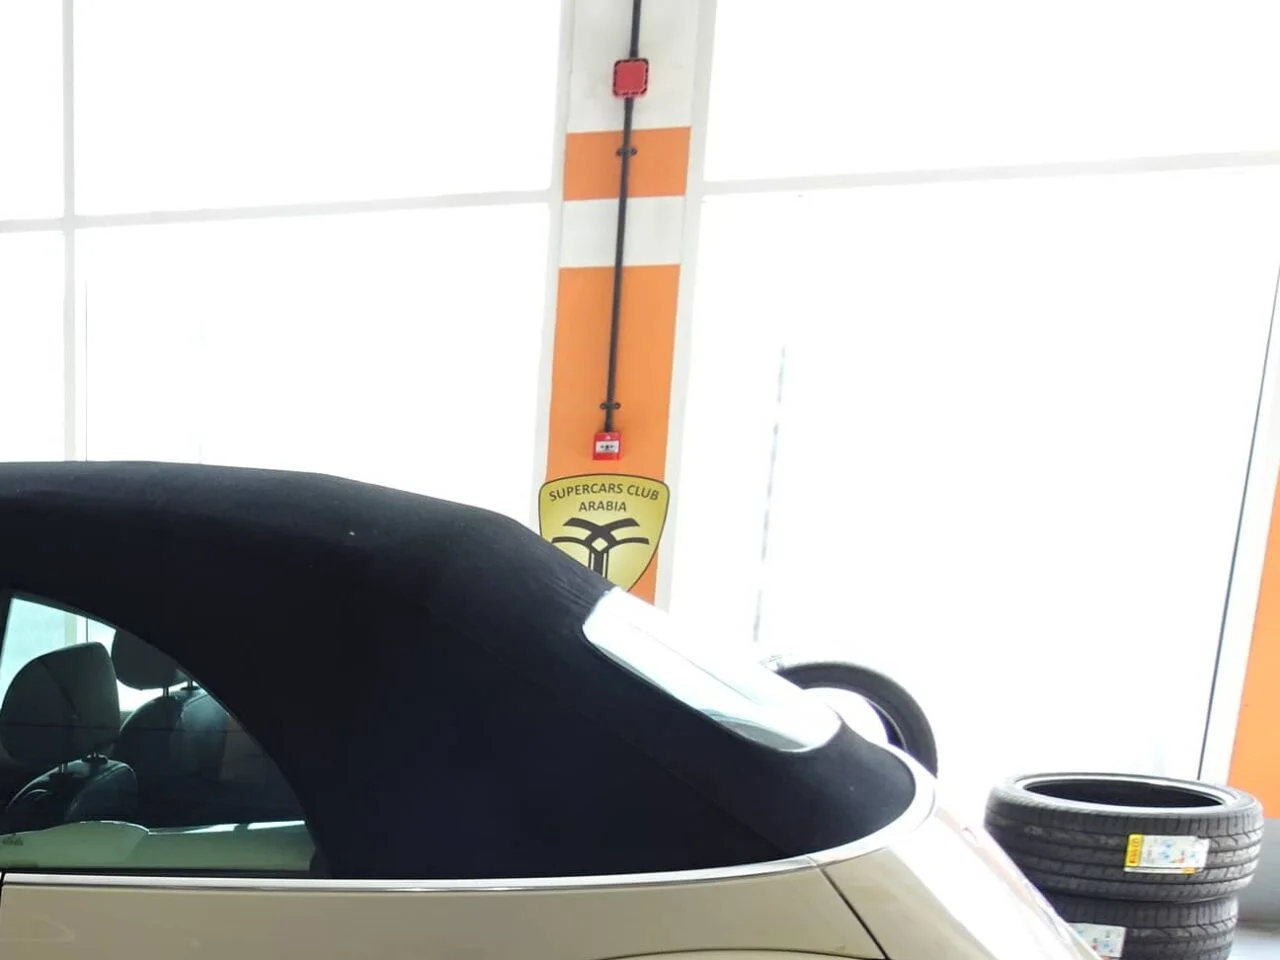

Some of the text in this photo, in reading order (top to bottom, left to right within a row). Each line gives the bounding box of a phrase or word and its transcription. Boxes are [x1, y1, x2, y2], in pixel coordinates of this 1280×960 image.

[548, 483, 660, 502] SUPERCARS CLUB
[578, 500, 628, 513] ARABIA
